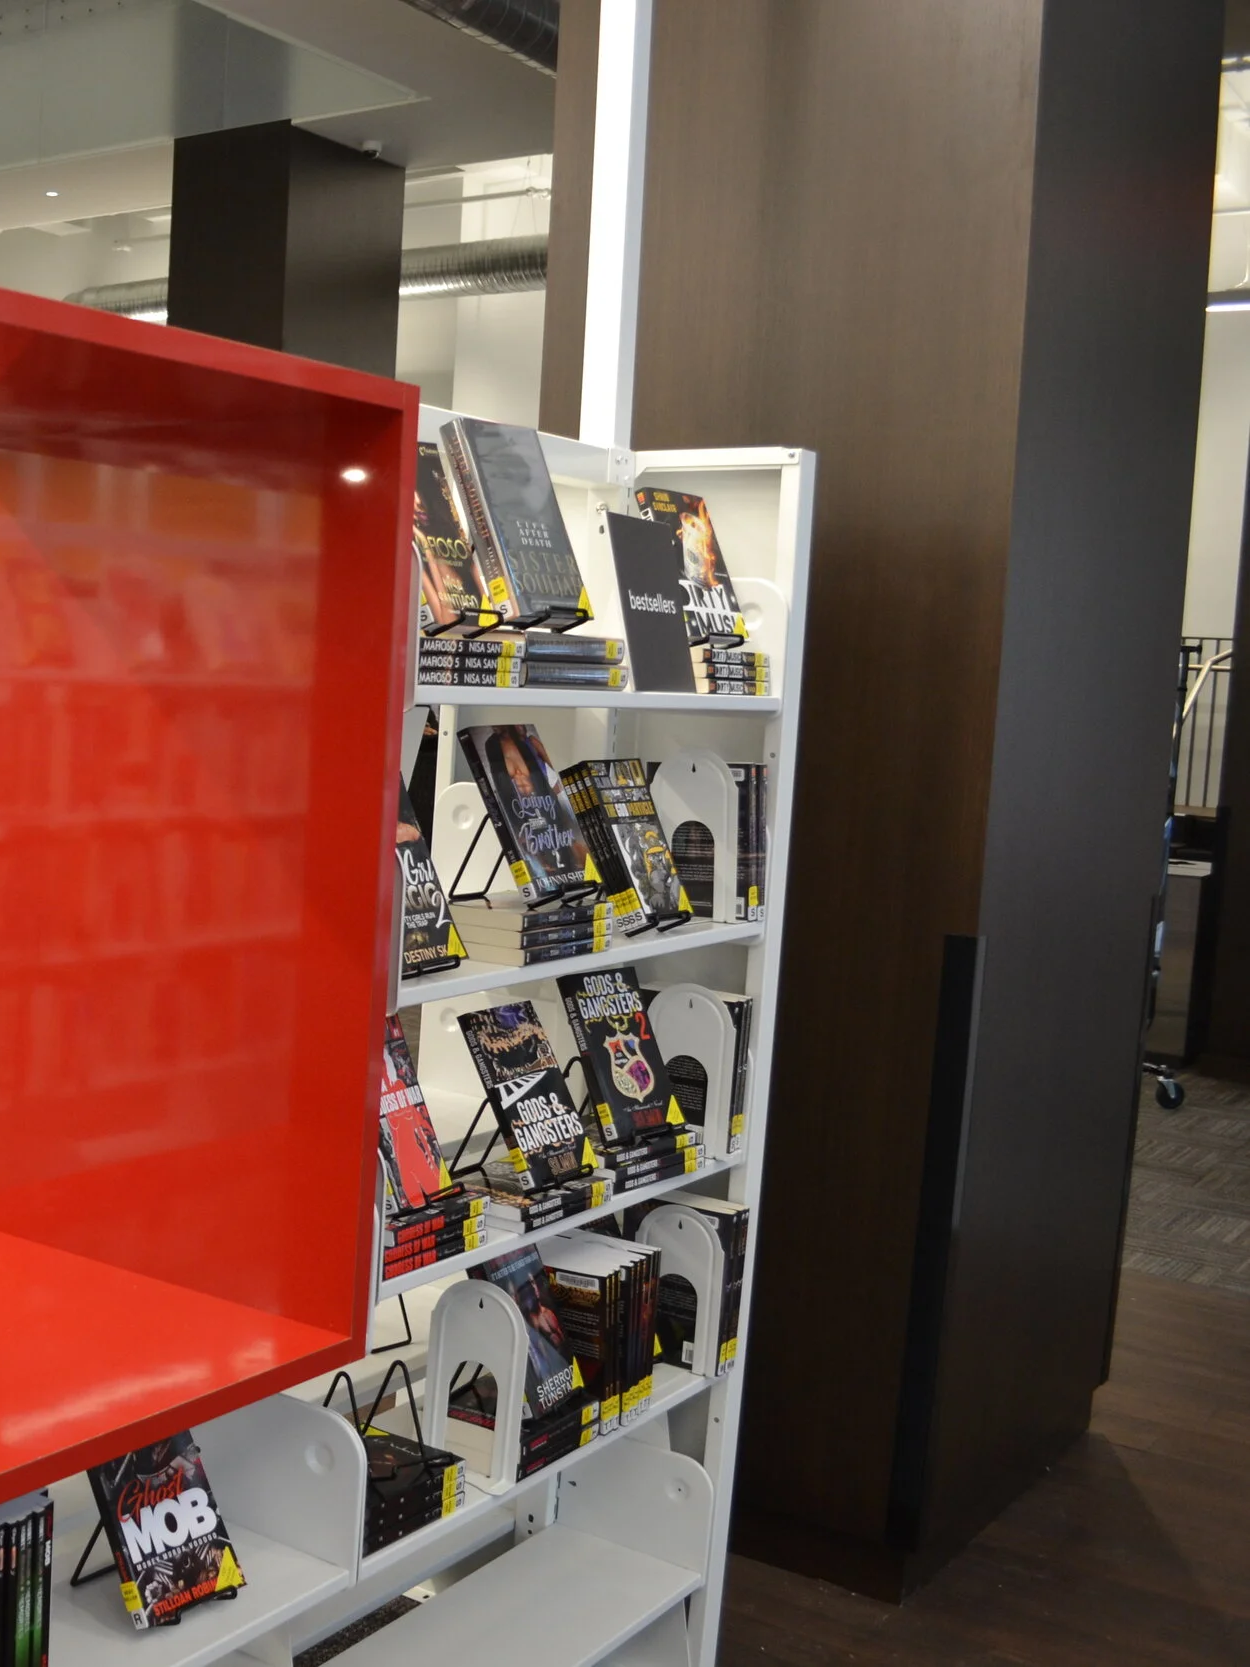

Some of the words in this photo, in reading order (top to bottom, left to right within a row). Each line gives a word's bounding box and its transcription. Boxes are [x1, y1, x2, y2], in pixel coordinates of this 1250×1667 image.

[516, 520, 549, 531] LIFE
[519, 529, 549, 539] AFTER
[521, 537, 552, 548] DEATH
[509, 549, 578, 574] SISTER
[514, 572, 584, 597] SOULJAH
[499, 604, 508, 615] S
[627, 589, 677, 615] bestsellers
[696, 611, 738, 634] MUSI
[423, 640, 457, 652] MAFIOSO
[468, 642, 485, 653] NISA
[419, 656, 453, 668] MAFIOSO
[465, 658, 482, 669] NISA
[418, 672, 452, 684] MAFIOSO
[463, 673, 480, 685] NISA
[519, 824, 575, 854] Brother
[403, 849, 435, 885] Girl
[552, 850, 565, 869] 2
[522, 887, 531, 898] S
[431, 890, 453, 929] 2
[403, 947, 438, 964] DESTINY
[583, 974, 614, 998] GODS
[615, 972, 630, 994] &
[578, 991, 643, 1020] GANGSTERS
[564, 997, 574, 1013] GODS
[571, 1018, 588, 1051] GANGSTERS
[634, 1011, 651, 1040] 2
[465, 1029, 477, 1049] GODS
[475, 1054, 494, 1089] GANGSTERS
[407, 1085, 423, 1105] WAR
[516, 1095, 549, 1126] GODS
[549, 1092, 566, 1114] &
[514, 1111, 584, 1152] GANGSTERS
[521, 1175, 530, 1186] S
[539, 1385, 573, 1410] TUNSTA
[117, 1467, 185, 1524] Ghost
[120, 1487, 218, 1565] MOB
[44, 1539, 52, 1567] MOB
[136, 1556, 161, 1572] MONEY
[162, 1546, 186, 1560] MURDA
[188, 1532, 218, 1550] VOODOO
[153, 1589, 193, 1618] STILLOAN
[133, 1613, 143, 1625] R
